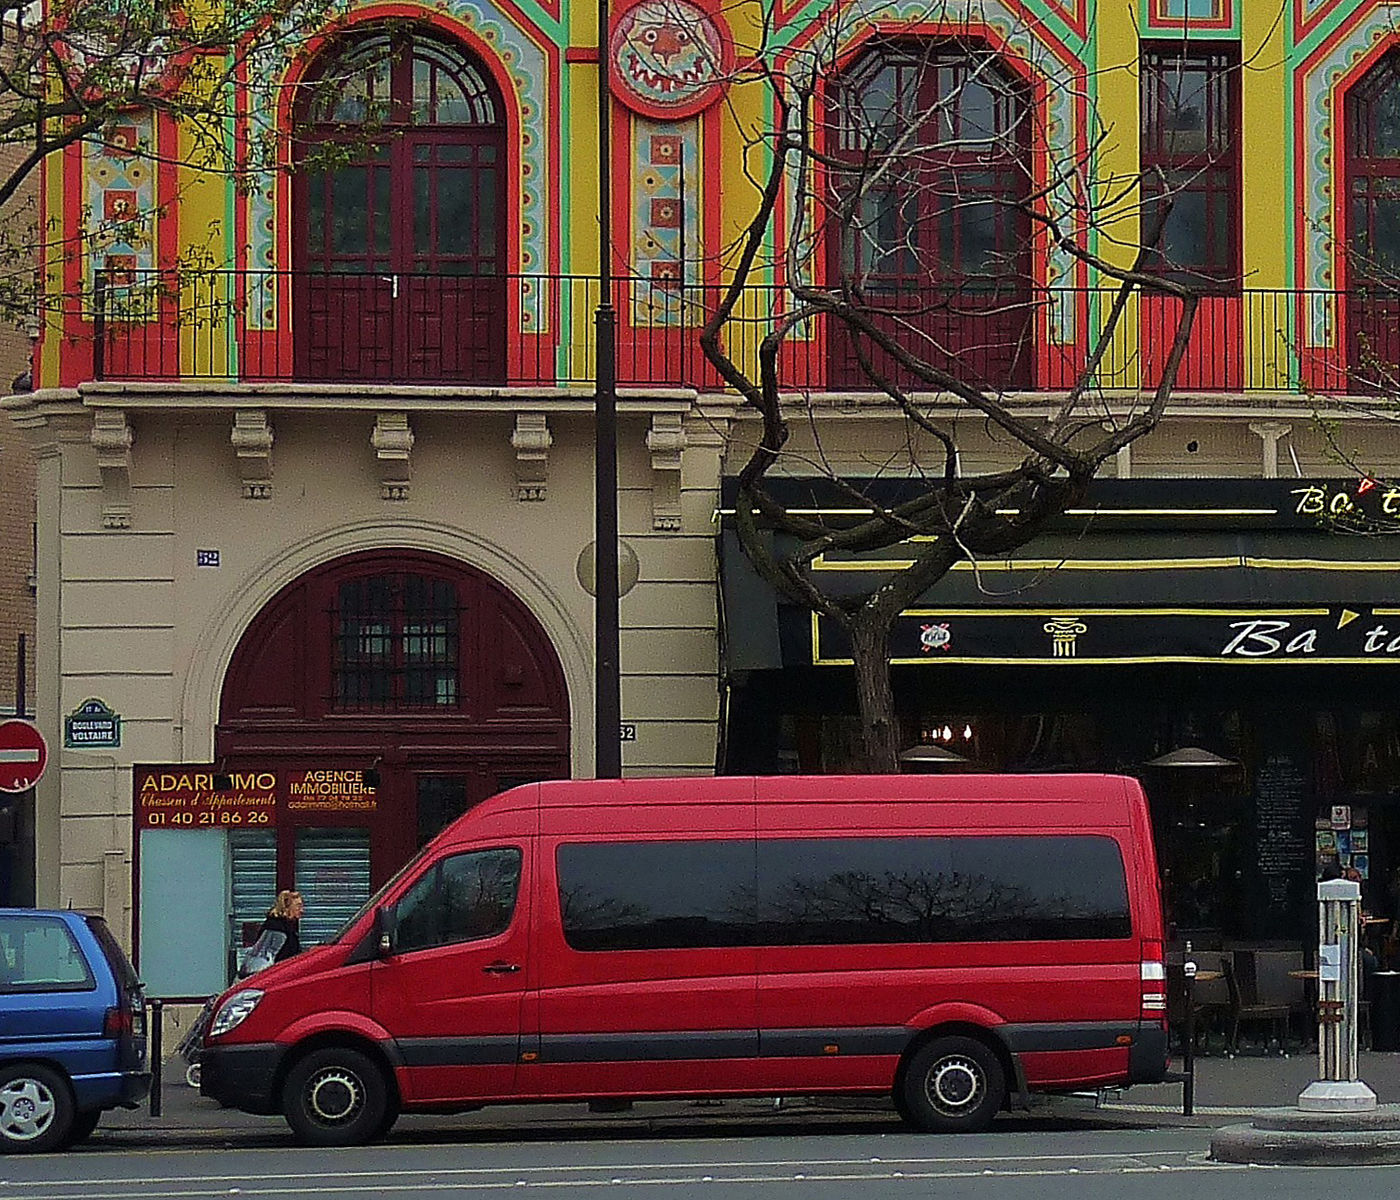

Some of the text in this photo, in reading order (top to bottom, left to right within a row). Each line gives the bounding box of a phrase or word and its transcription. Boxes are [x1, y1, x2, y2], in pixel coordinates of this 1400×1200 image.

[1221, 619, 1318, 657] Ba
[71, 731, 113, 740] VOLTAIRE
[141, 773, 276, 792] ADARIMO
[304, 770, 363, 783] AGENCE
[148, 811, 269, 825] 01 40 21 86 26
